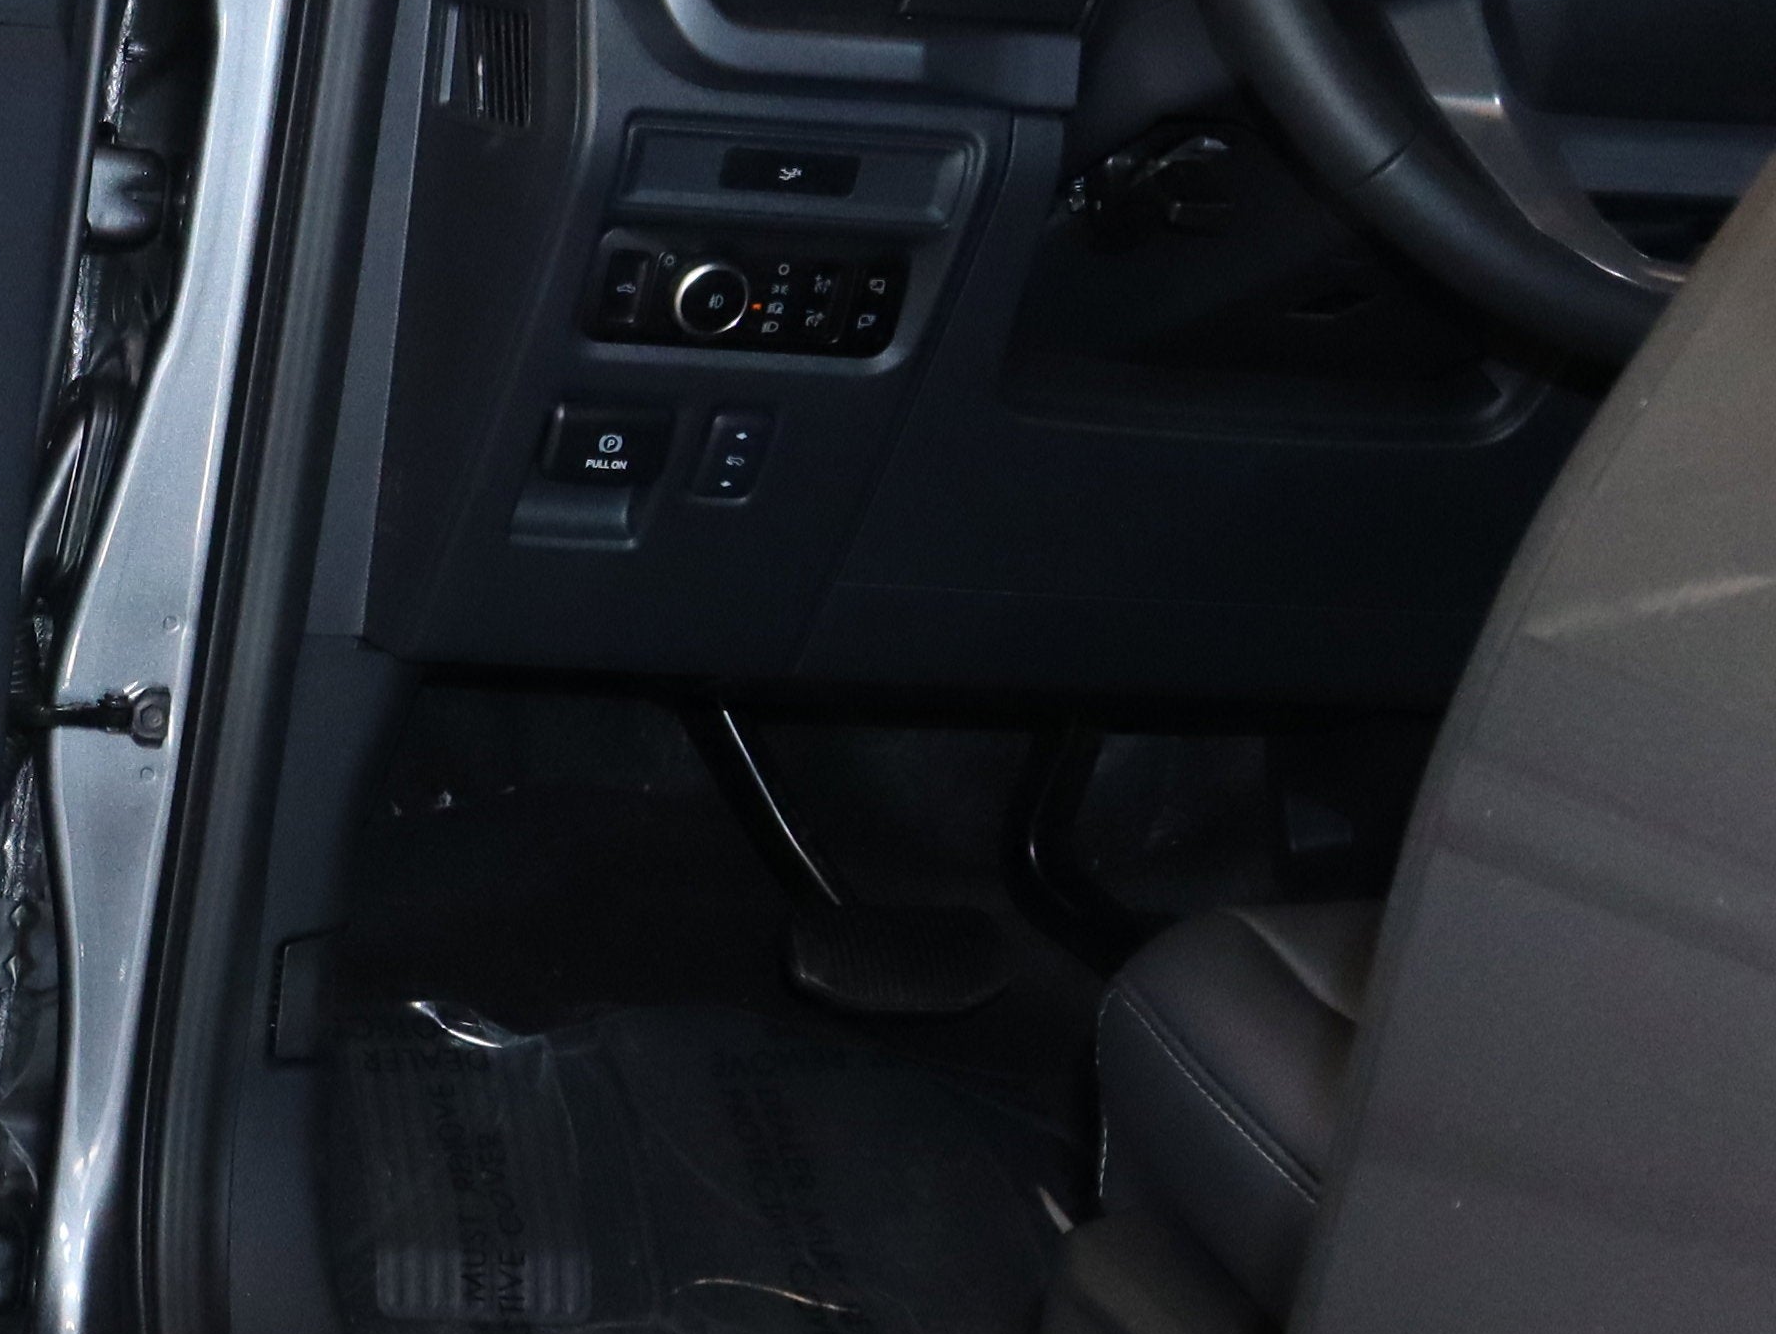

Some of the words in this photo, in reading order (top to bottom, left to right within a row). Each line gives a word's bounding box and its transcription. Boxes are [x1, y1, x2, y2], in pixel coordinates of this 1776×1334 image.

[585, 458, 609, 469] PULL
[611, 460, 628, 470] ON
[458, 1212, 487, 1302] MUST
